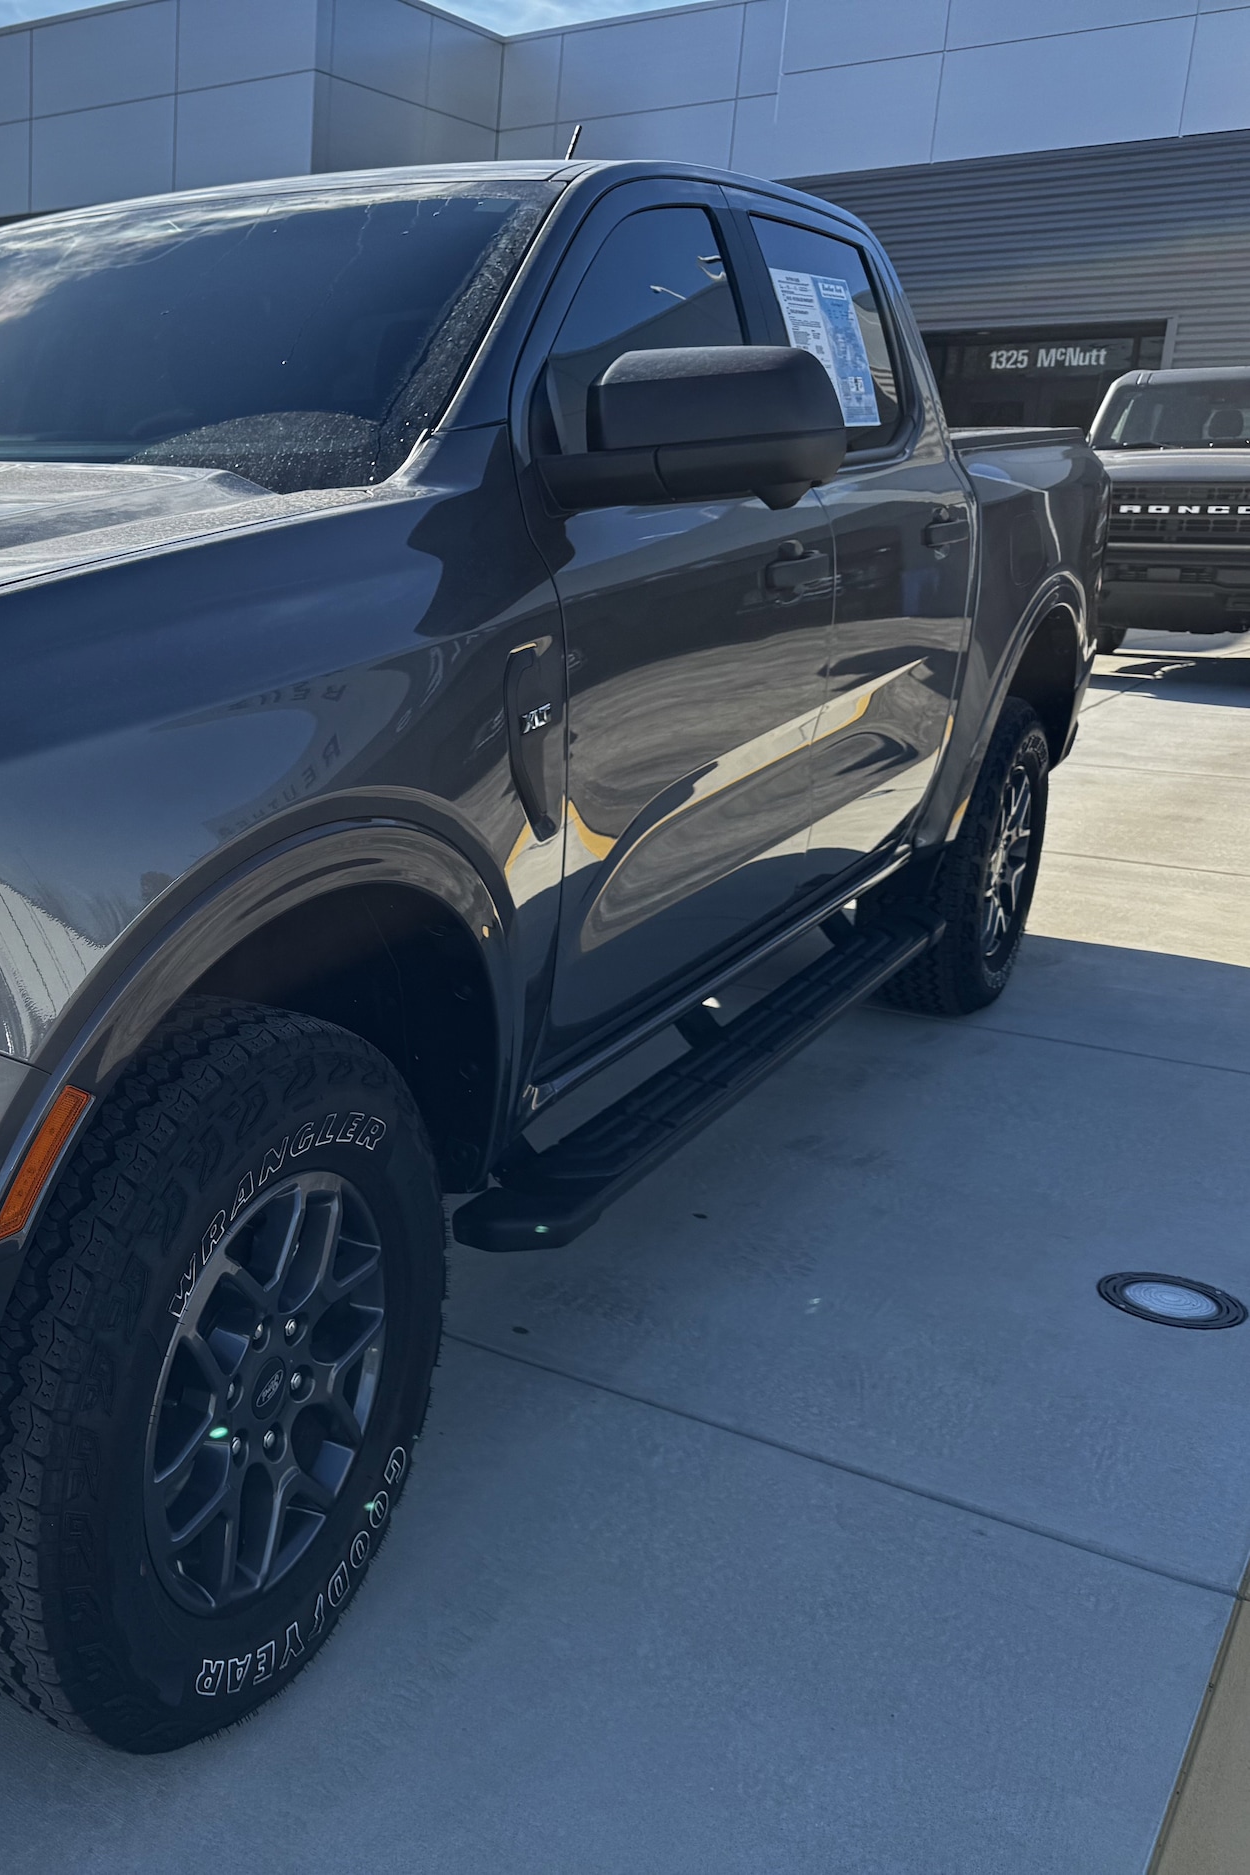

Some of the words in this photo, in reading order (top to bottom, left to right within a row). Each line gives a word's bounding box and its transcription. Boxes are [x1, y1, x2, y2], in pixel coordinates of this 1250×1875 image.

[989, 349, 1029, 370] 1325
[1036, 346, 1108, 368] McNutt
[1118, 504, 1250, 515] RONCO
[521, 702, 552, 734] XLT
[168, 1110, 387, 1320] WRANGLER
[195, 1445, 407, 1697] GOODYEAR
